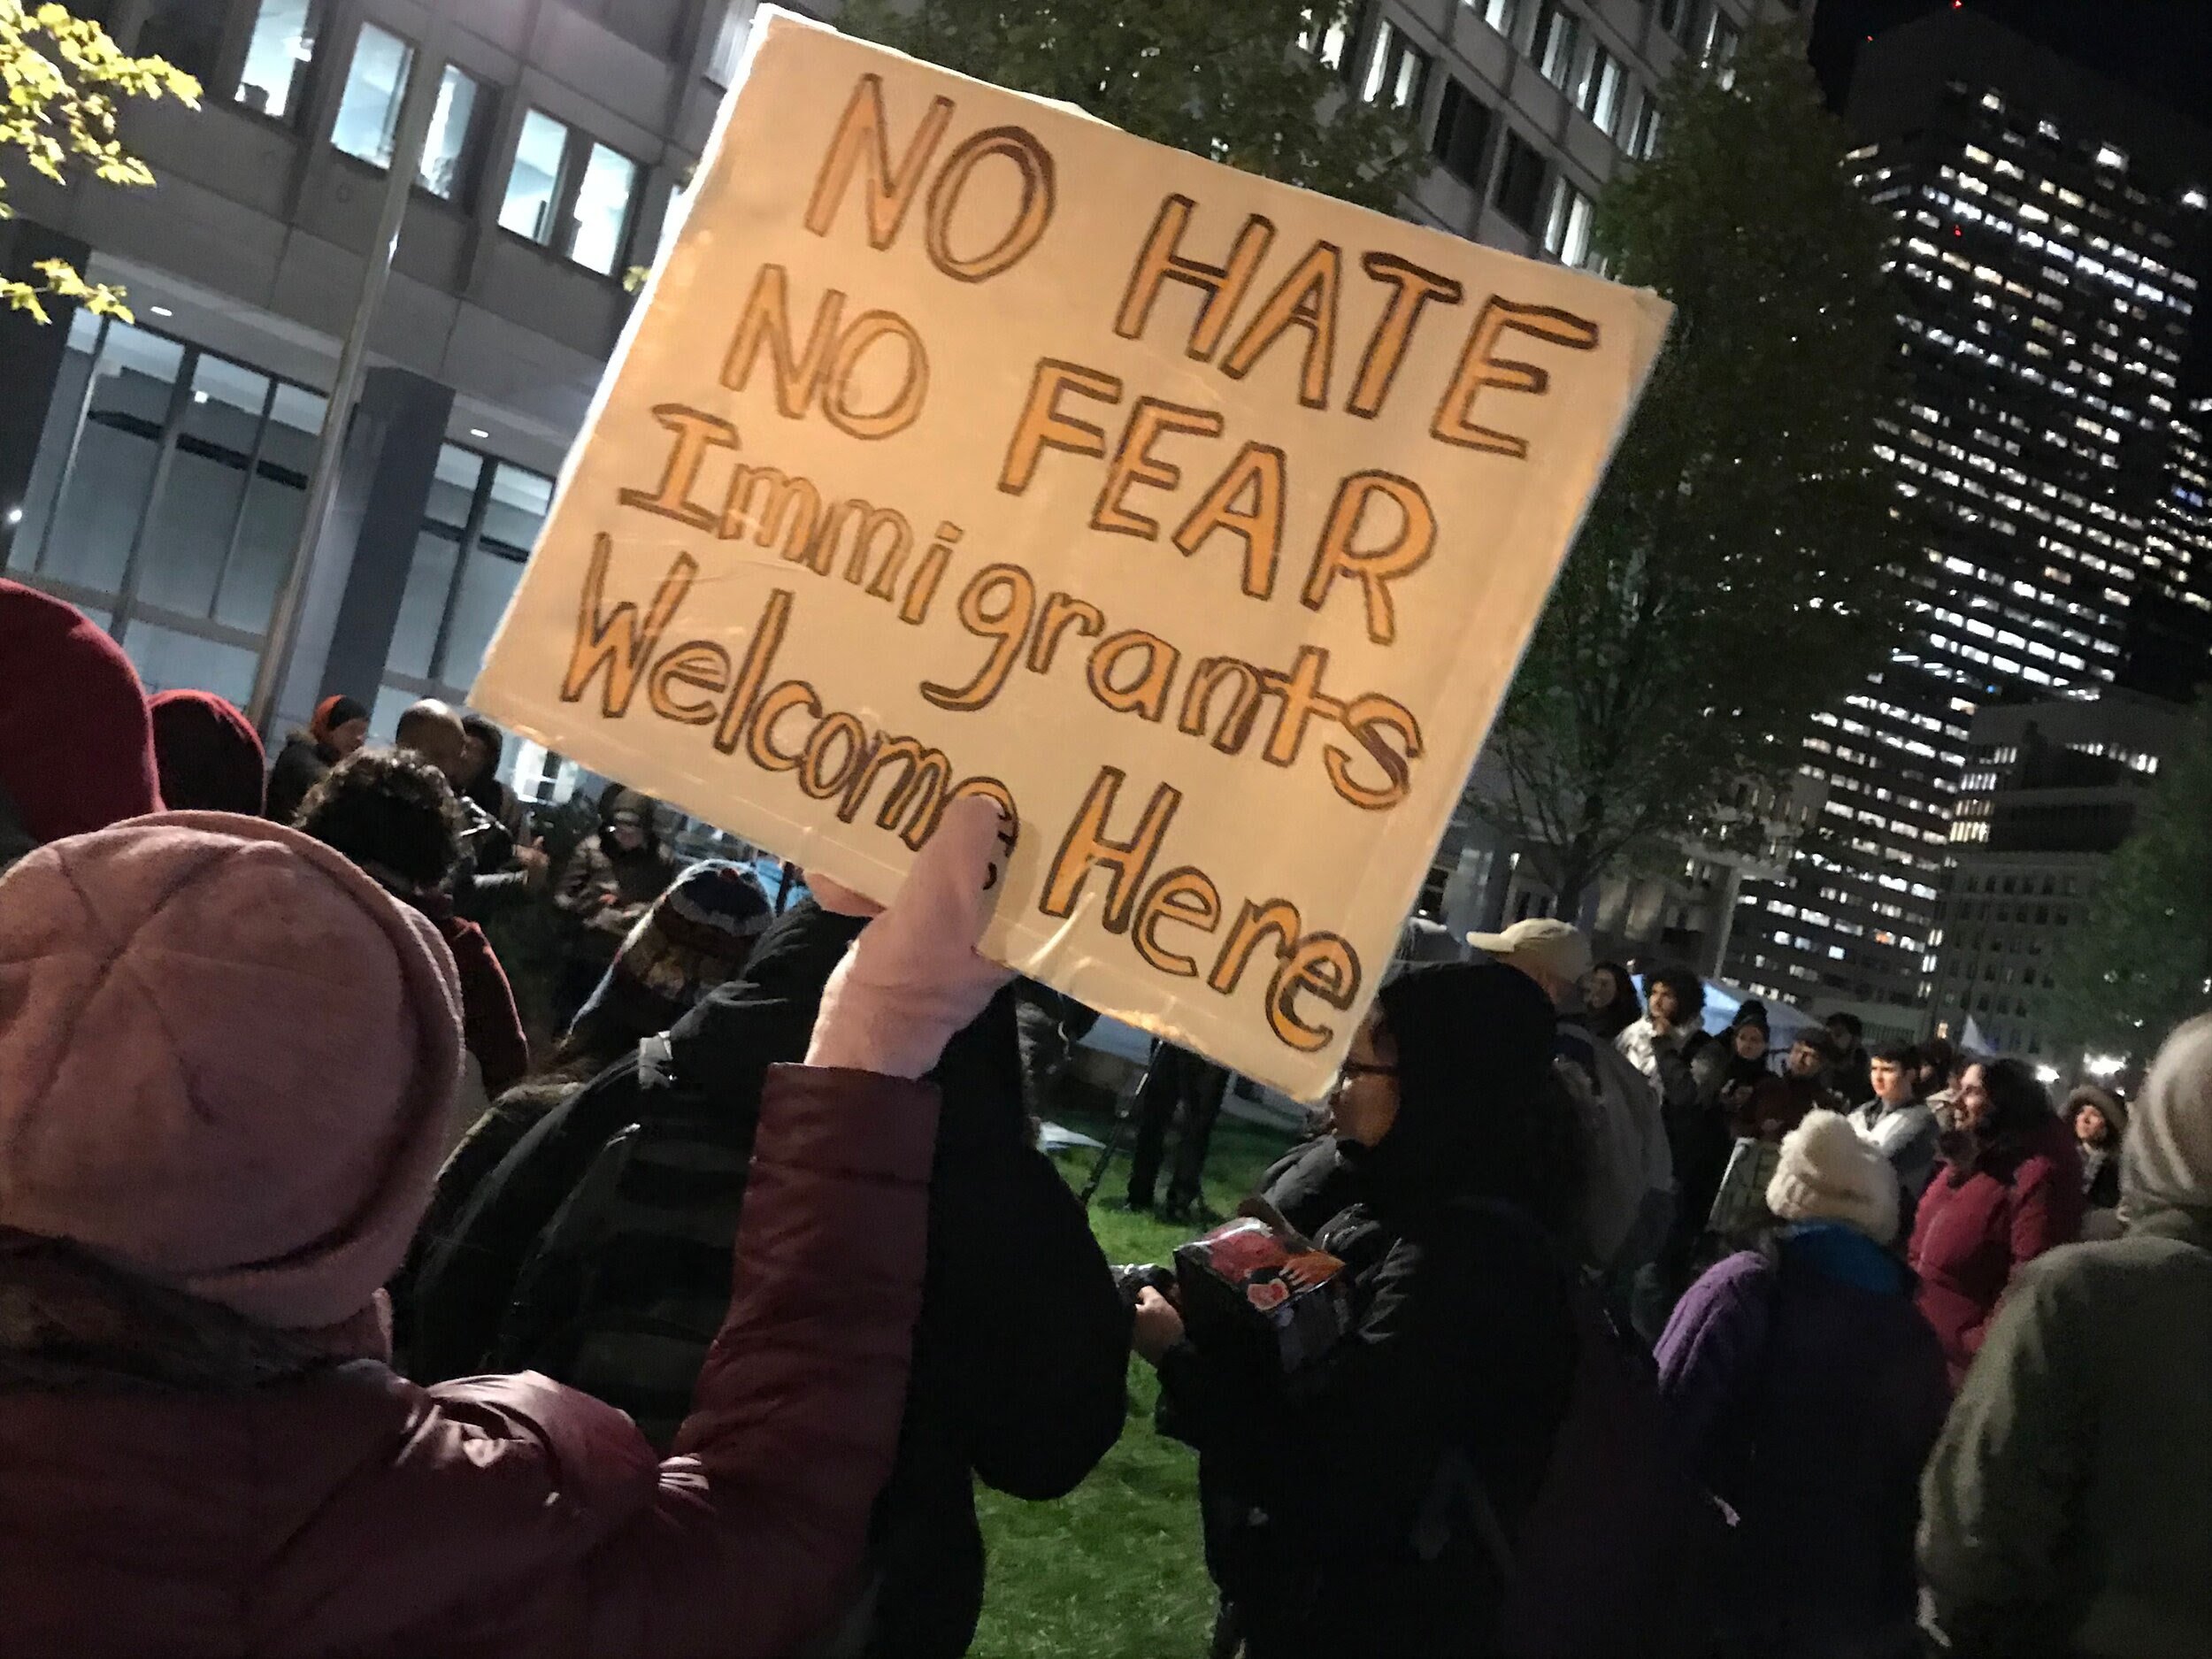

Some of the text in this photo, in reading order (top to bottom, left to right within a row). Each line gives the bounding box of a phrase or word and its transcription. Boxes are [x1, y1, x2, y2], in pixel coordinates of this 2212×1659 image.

[720, 264, 1438, 646] NO FEAR
[805, 73, 1599, 459] NO HATE
[618, 403, 1423, 810] Immigrants
[1039, 765, 1362, 1052] Here
